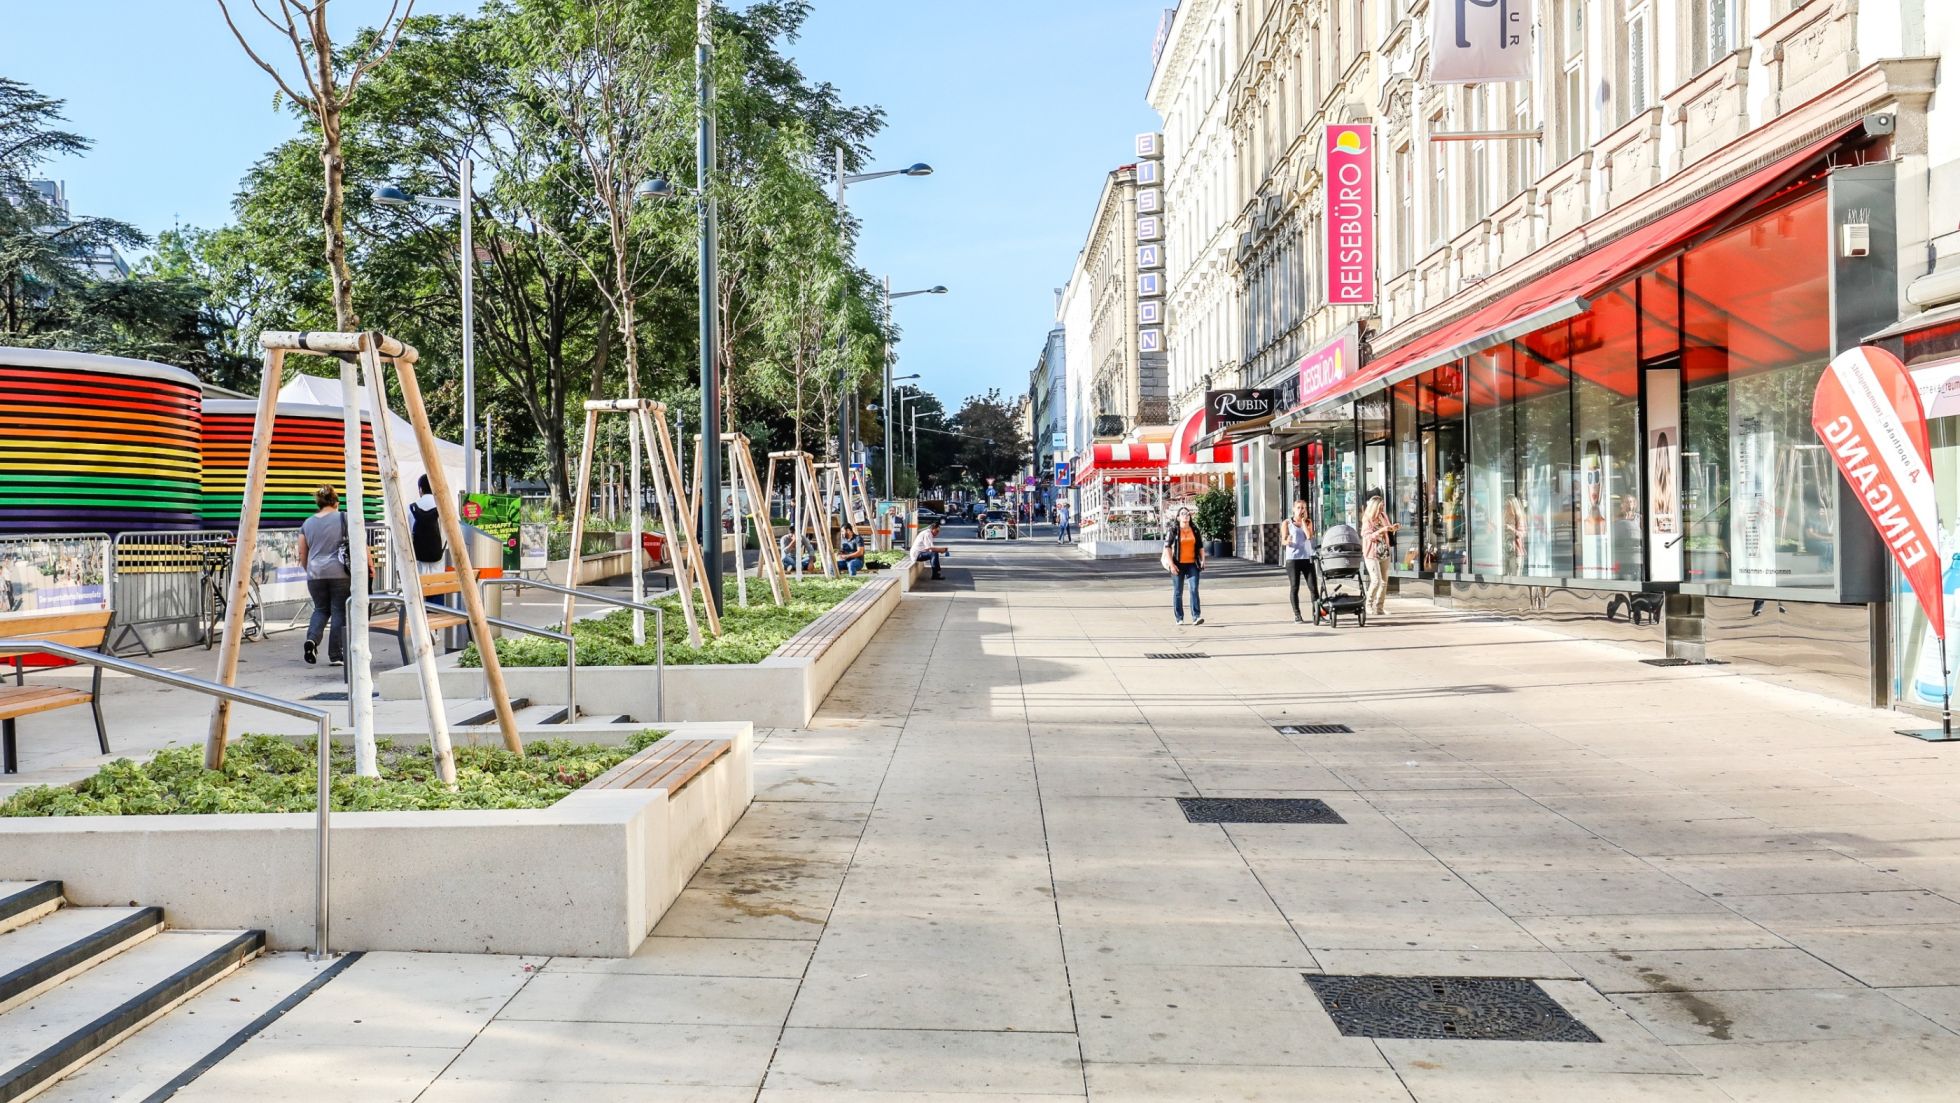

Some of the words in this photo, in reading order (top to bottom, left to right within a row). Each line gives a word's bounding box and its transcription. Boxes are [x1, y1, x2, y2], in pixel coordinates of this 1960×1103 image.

[1138, 134, 1158, 350] EISSALON
[1335, 164, 1362, 298] REISEBÜRO
[1214, 393, 1268, 416] RUBIN
[1303, 354, 1334, 396] REISEBÜRO
